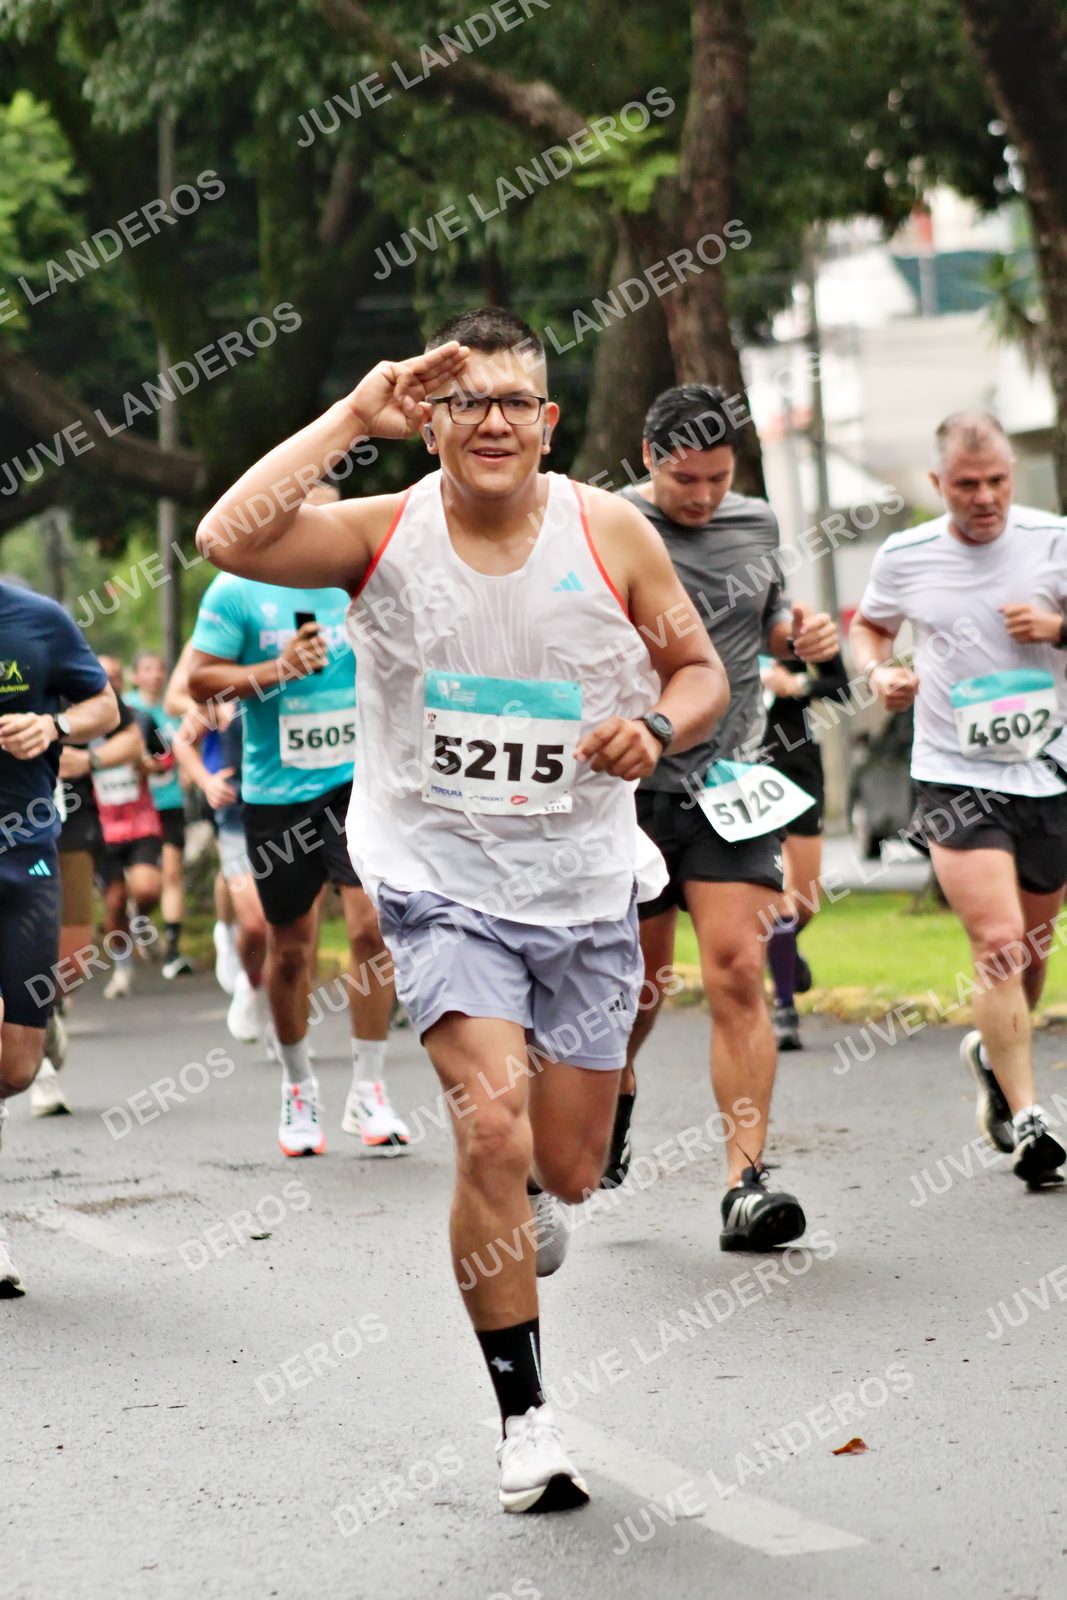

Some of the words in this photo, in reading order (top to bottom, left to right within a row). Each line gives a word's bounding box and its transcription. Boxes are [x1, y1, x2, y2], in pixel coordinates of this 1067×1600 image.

[288, 722, 355, 750] 5605
[431, 734, 564, 784] 5215
[712, 779, 785, 826] 5120
